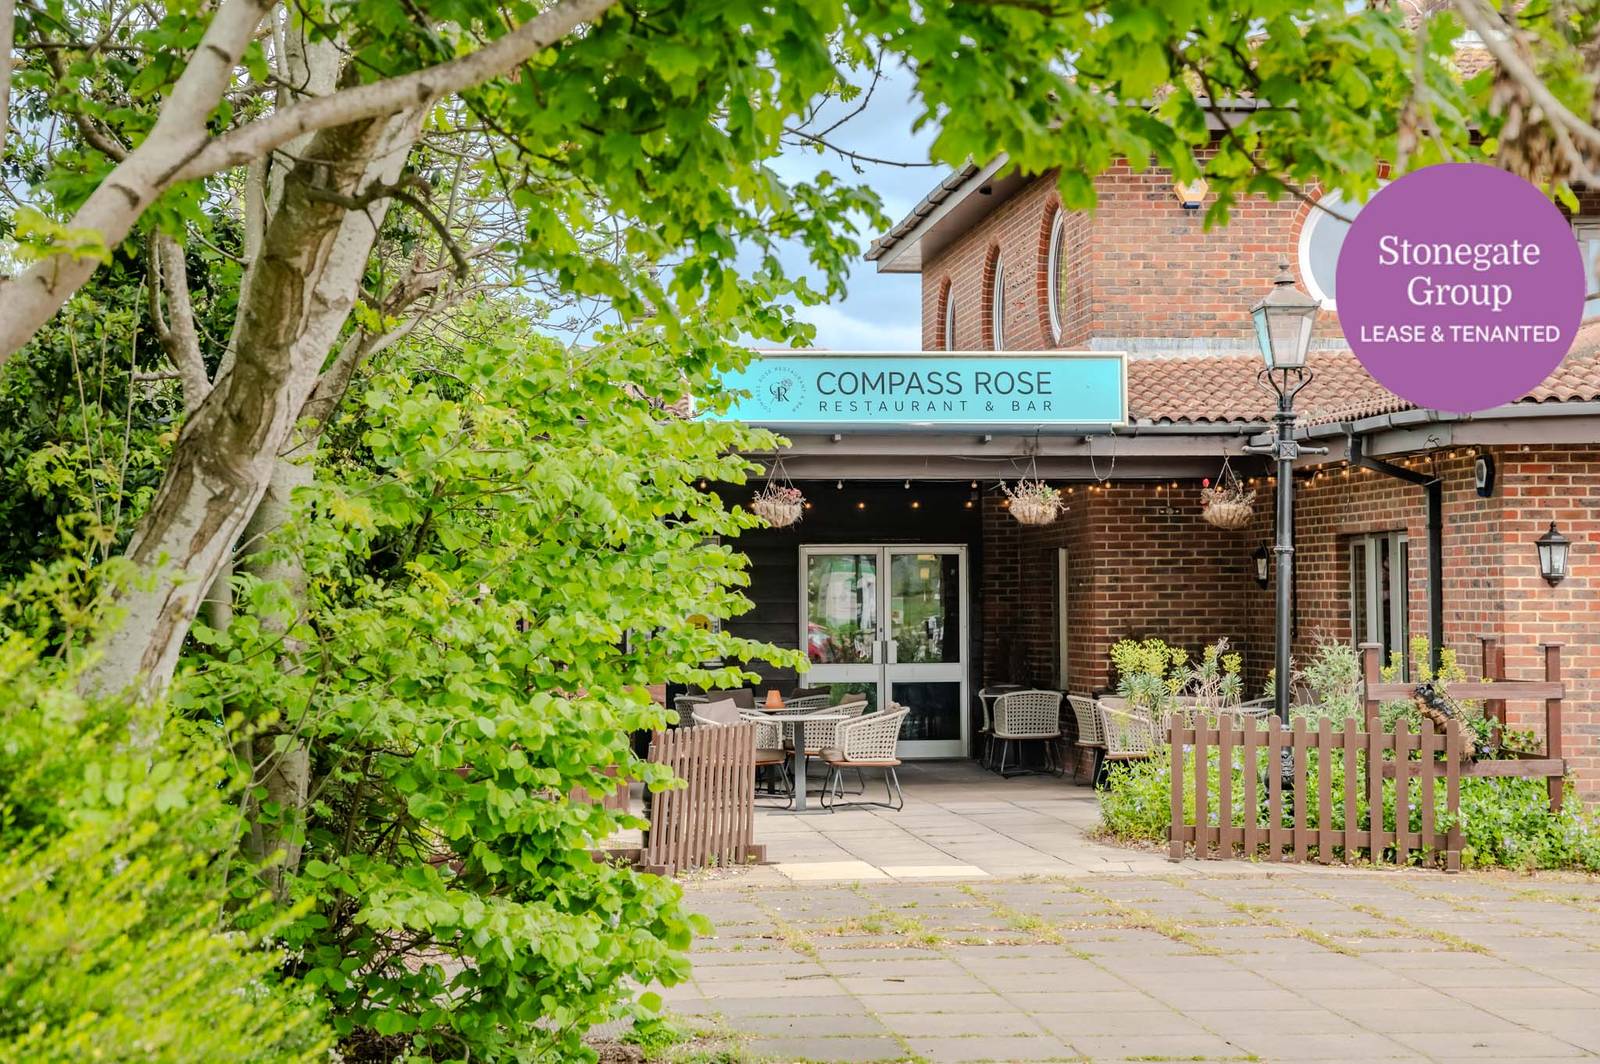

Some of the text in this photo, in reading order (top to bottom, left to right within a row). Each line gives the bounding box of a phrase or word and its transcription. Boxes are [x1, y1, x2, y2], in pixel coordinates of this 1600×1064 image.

[816, 370, 1053, 396] COMPASS ROSE
[819, 400, 968, 412] RESTAURANT
[985, 400, 995, 412] &
[1011, 400, 1052, 412] BAR
